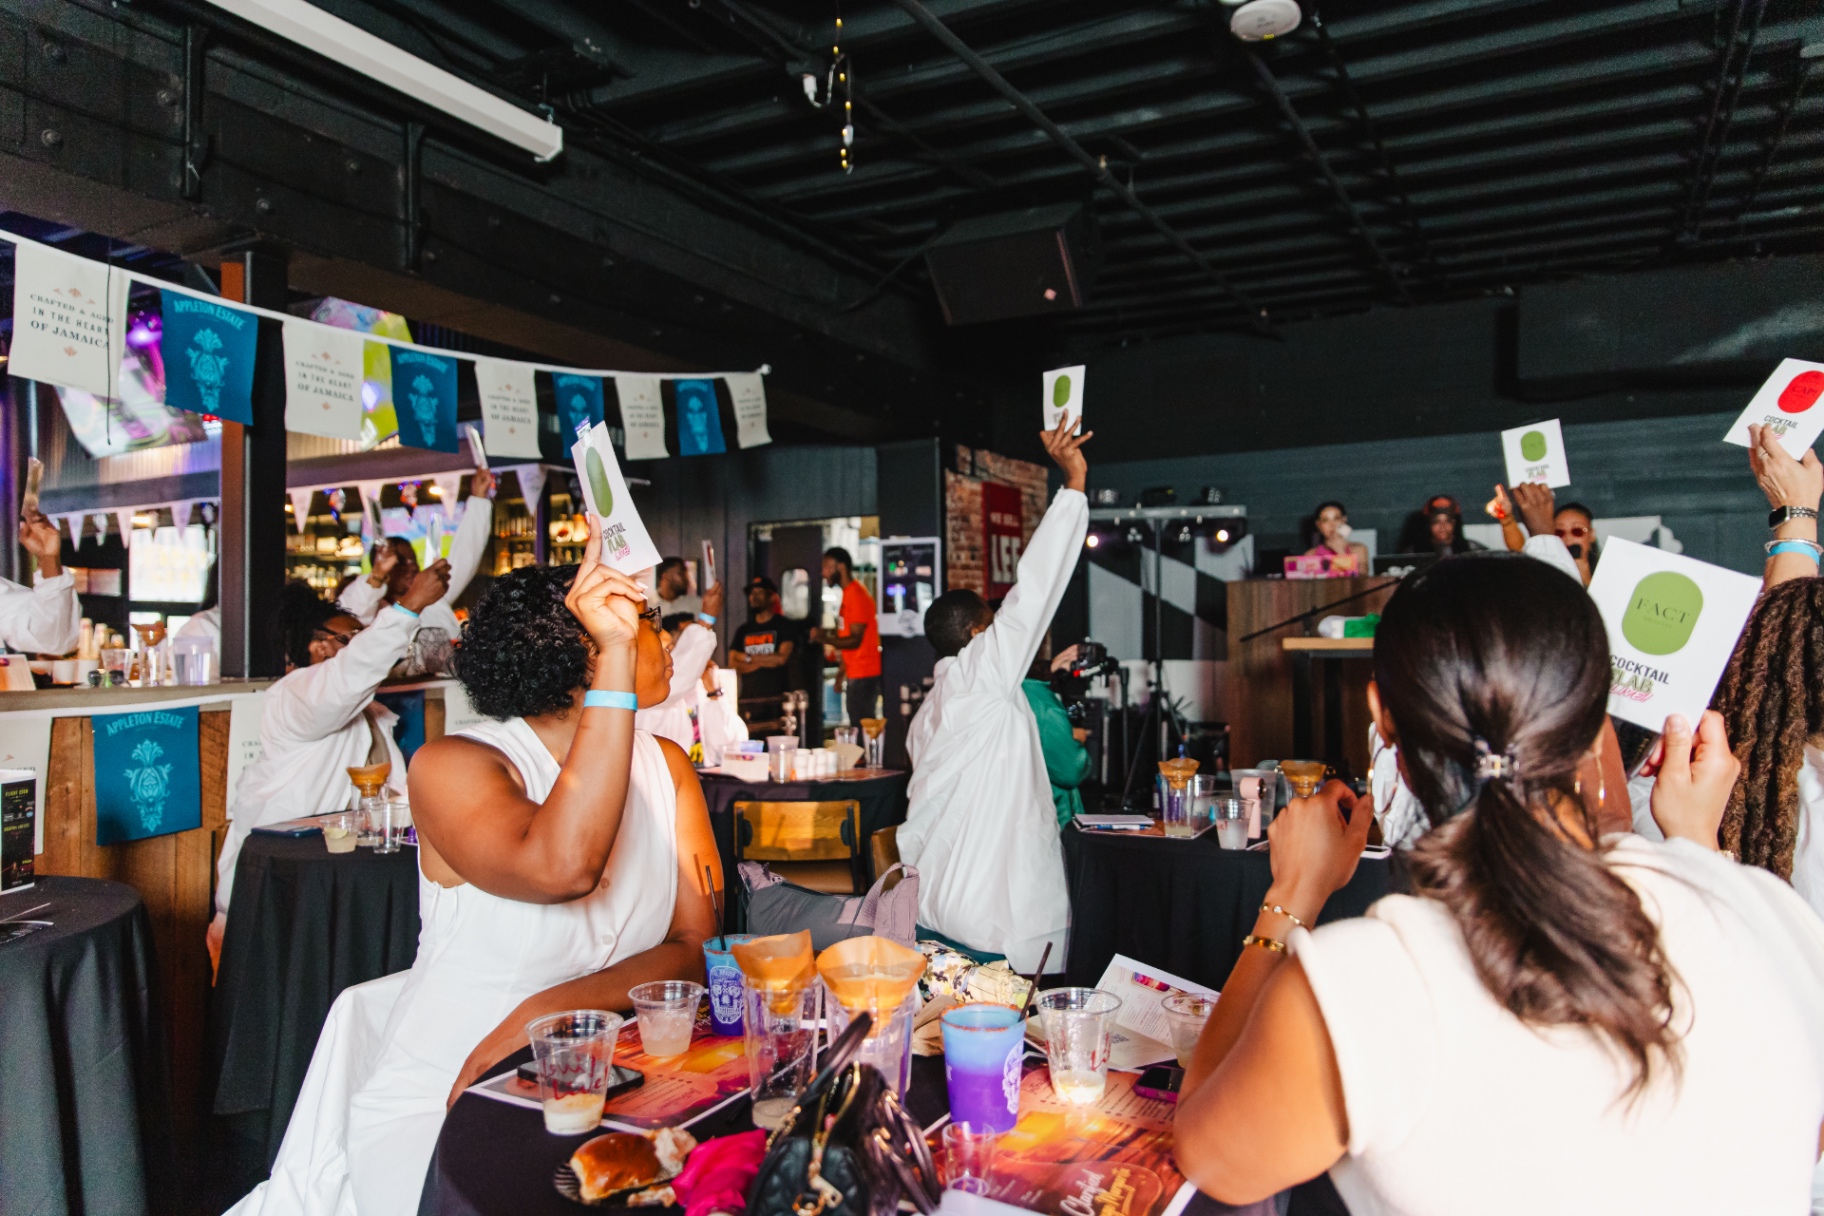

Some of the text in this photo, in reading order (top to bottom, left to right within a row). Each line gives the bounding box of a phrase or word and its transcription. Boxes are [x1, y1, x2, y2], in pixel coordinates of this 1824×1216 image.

[30, 293, 75, 312] CRAFTED
[33, 306, 44, 317] IN
[51, 311, 70, 325] THE
[30, 320, 48, 331] OF
[1764, 414, 1798, 430] COCKTAIL
[602, 522, 626, 541] COCKTAIL
[1637, 597, 1691, 623] FACT
[1609, 655, 1670, 685] COCKTAIL
[106, 711, 185, 737] APPLETON ESTATE
